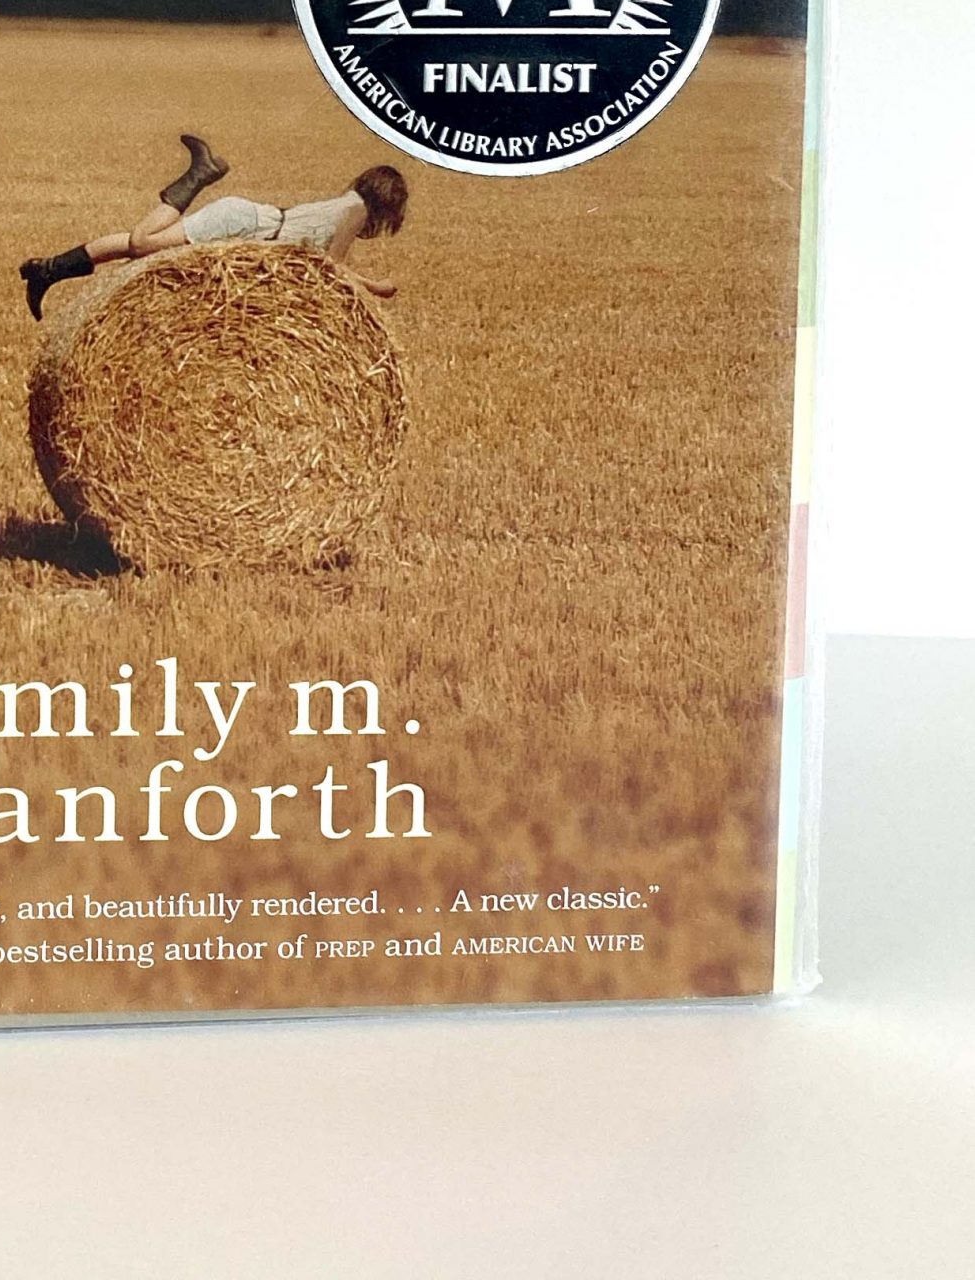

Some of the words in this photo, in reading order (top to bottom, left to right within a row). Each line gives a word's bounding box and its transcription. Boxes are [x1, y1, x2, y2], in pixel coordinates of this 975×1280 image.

[422, 62, 598, 94] FINALIST
[332, 42, 436, 140] AMERICAN
[439, 124, 538, 157] LIBRARY
[545, 40, 685, 153] ASSOCIATION
[287, 678, 421, 737] m.
[17, 894, 75, 921] and
[83, 891, 243, 924] beautifully
[450, 890, 471, 913] A
[479, 893, 539, 913] new
[546, 884, 661, 911] classic.”
[164, 934, 268, 962] author
[276, 933, 308, 960] of
[314, 940, 376, 958] PREP
[384, 932, 443, 958] and
[451, 935, 576, 957] AMERICAN
[585, 933, 646, 953] WIFE
